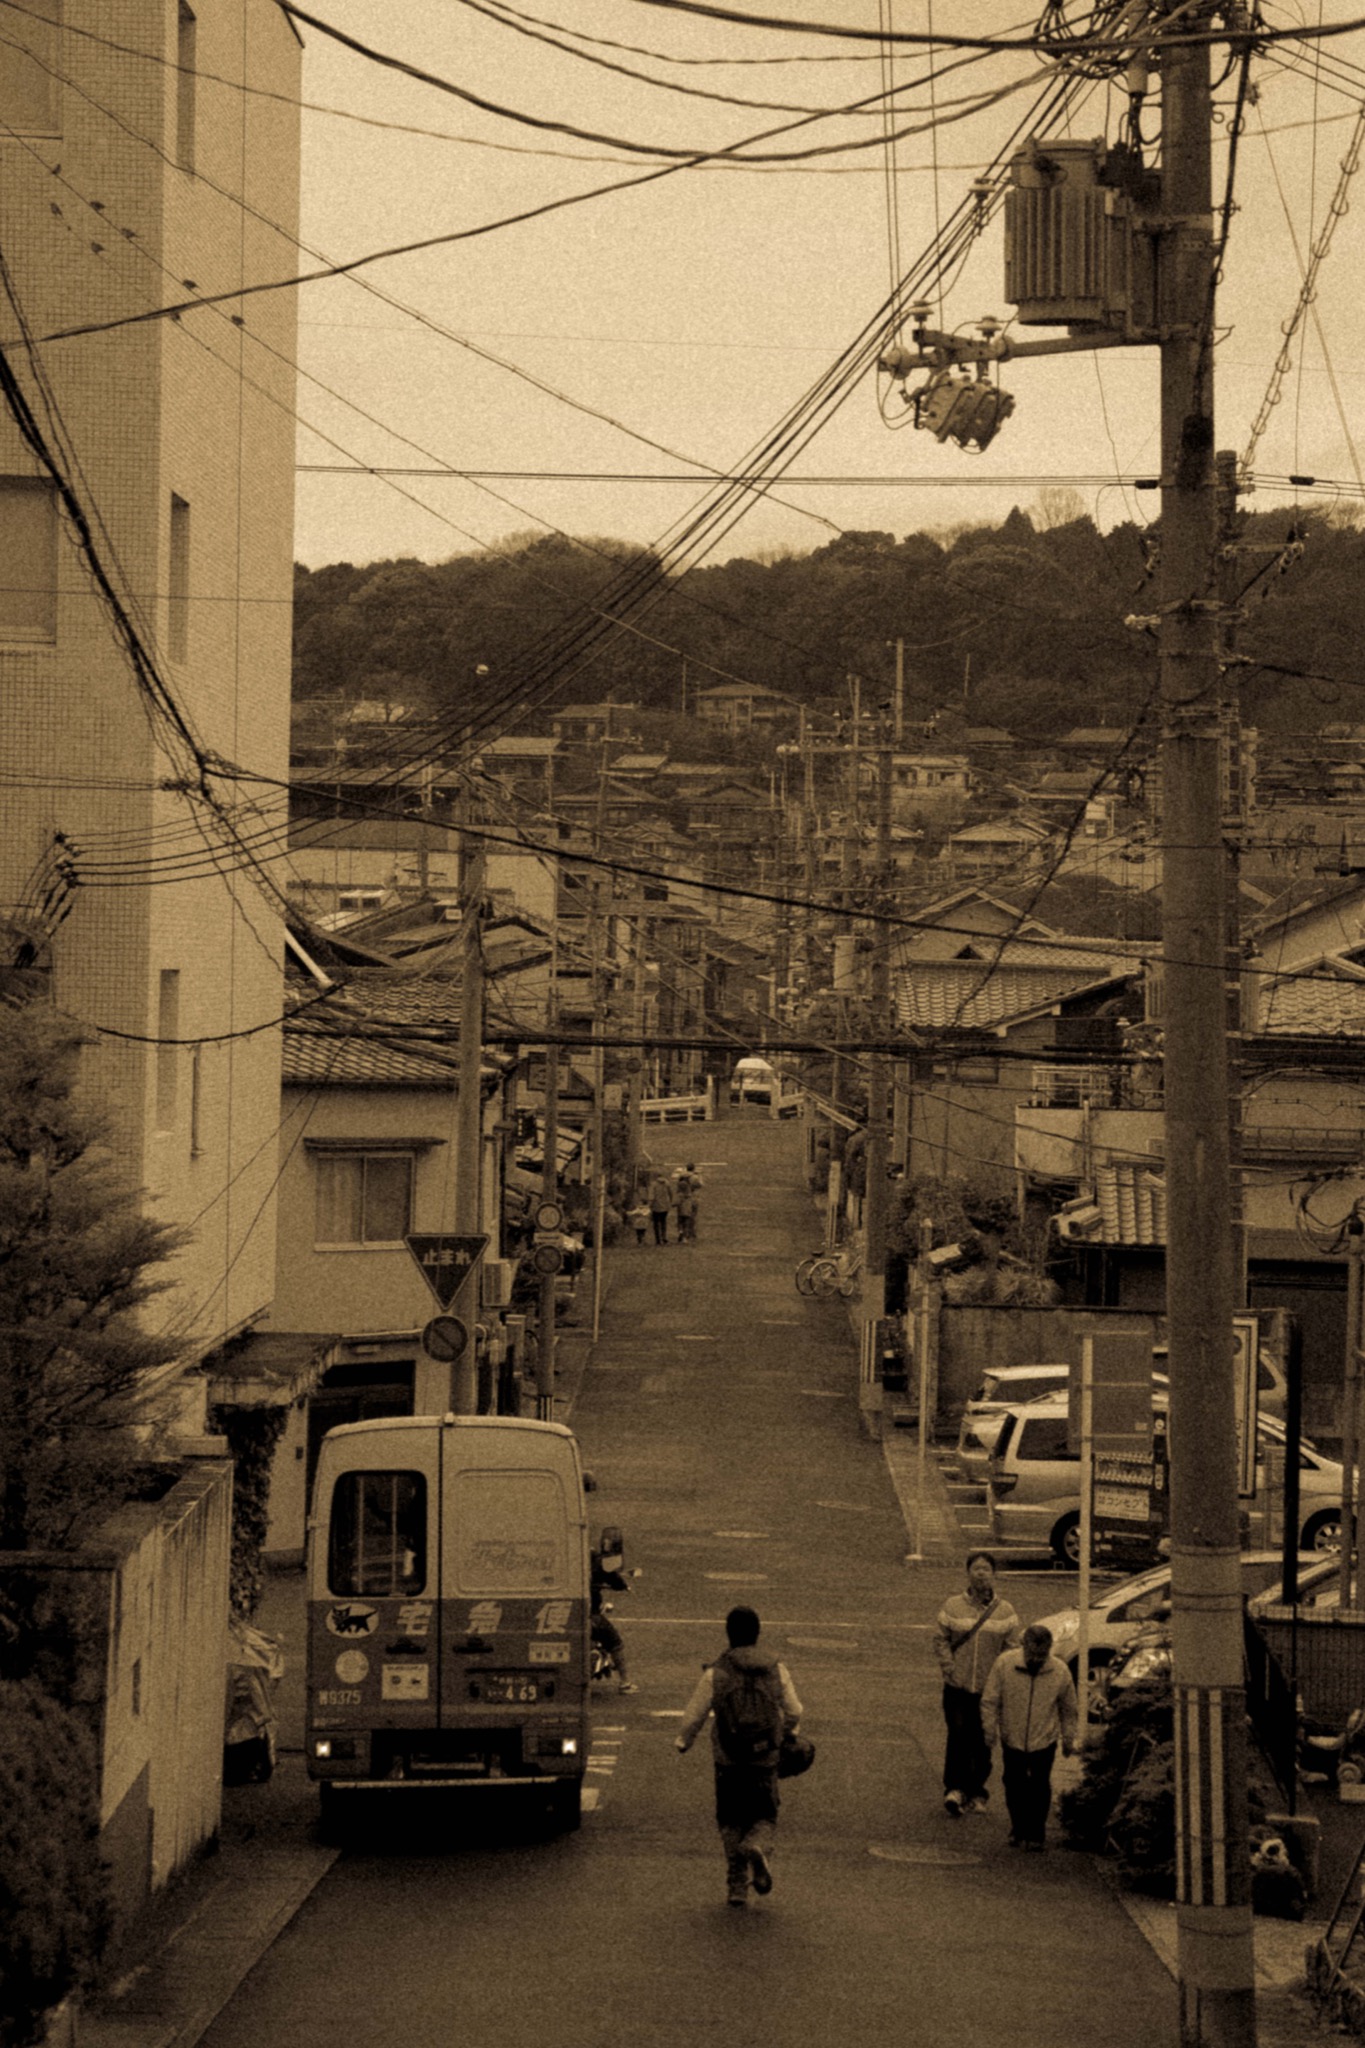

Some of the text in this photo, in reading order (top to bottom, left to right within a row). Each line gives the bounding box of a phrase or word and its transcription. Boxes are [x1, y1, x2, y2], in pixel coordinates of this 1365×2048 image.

[423, 1248, 472, 1265] 止まれ
[397, 1601, 573, 1635] 宅急便
